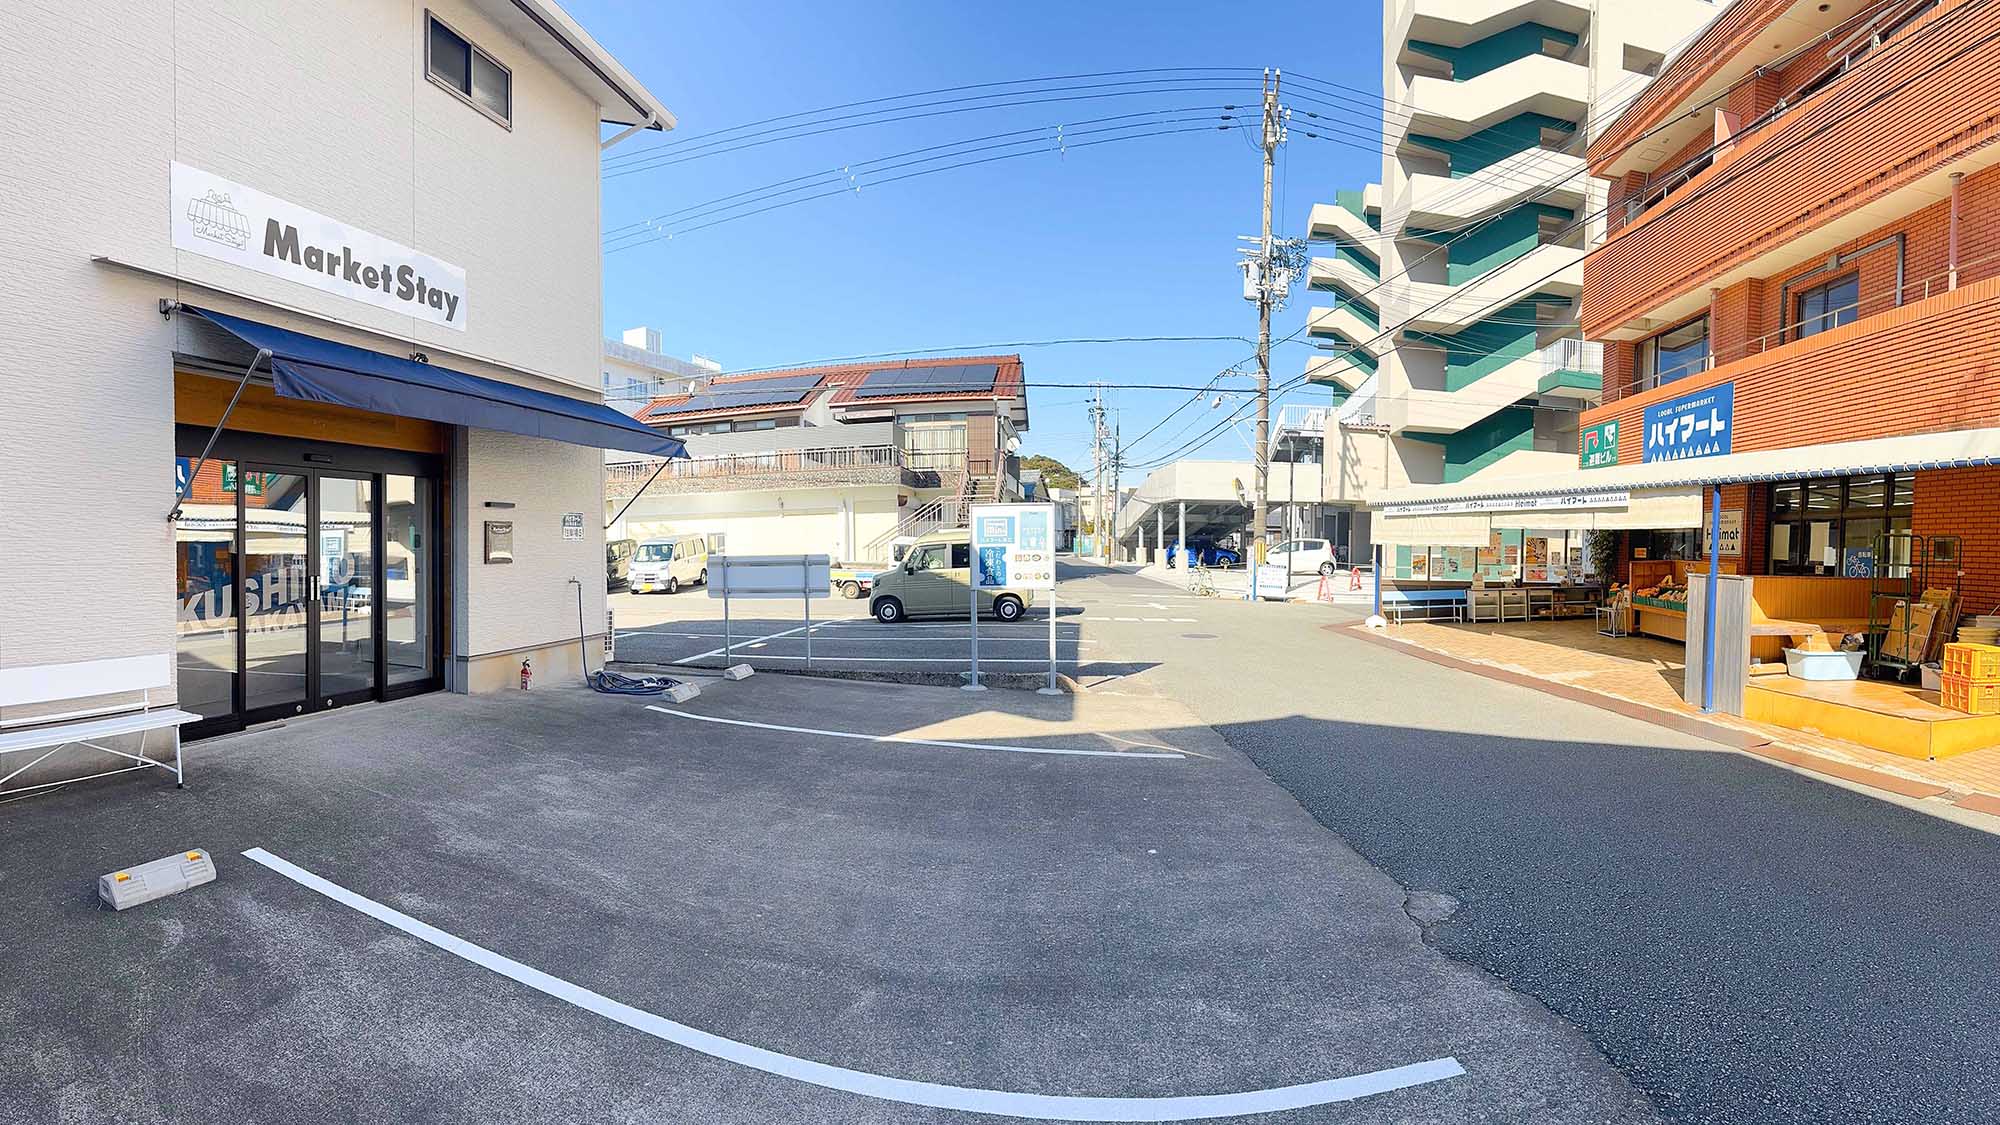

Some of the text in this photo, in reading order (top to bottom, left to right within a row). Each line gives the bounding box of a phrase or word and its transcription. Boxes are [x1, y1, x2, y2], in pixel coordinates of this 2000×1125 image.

[1657, 396, 1715, 418] LOCAL SUPERMARKET
[1649, 407, 1726, 449] ハイマート
[1706, 528, 1740, 540] Himat
